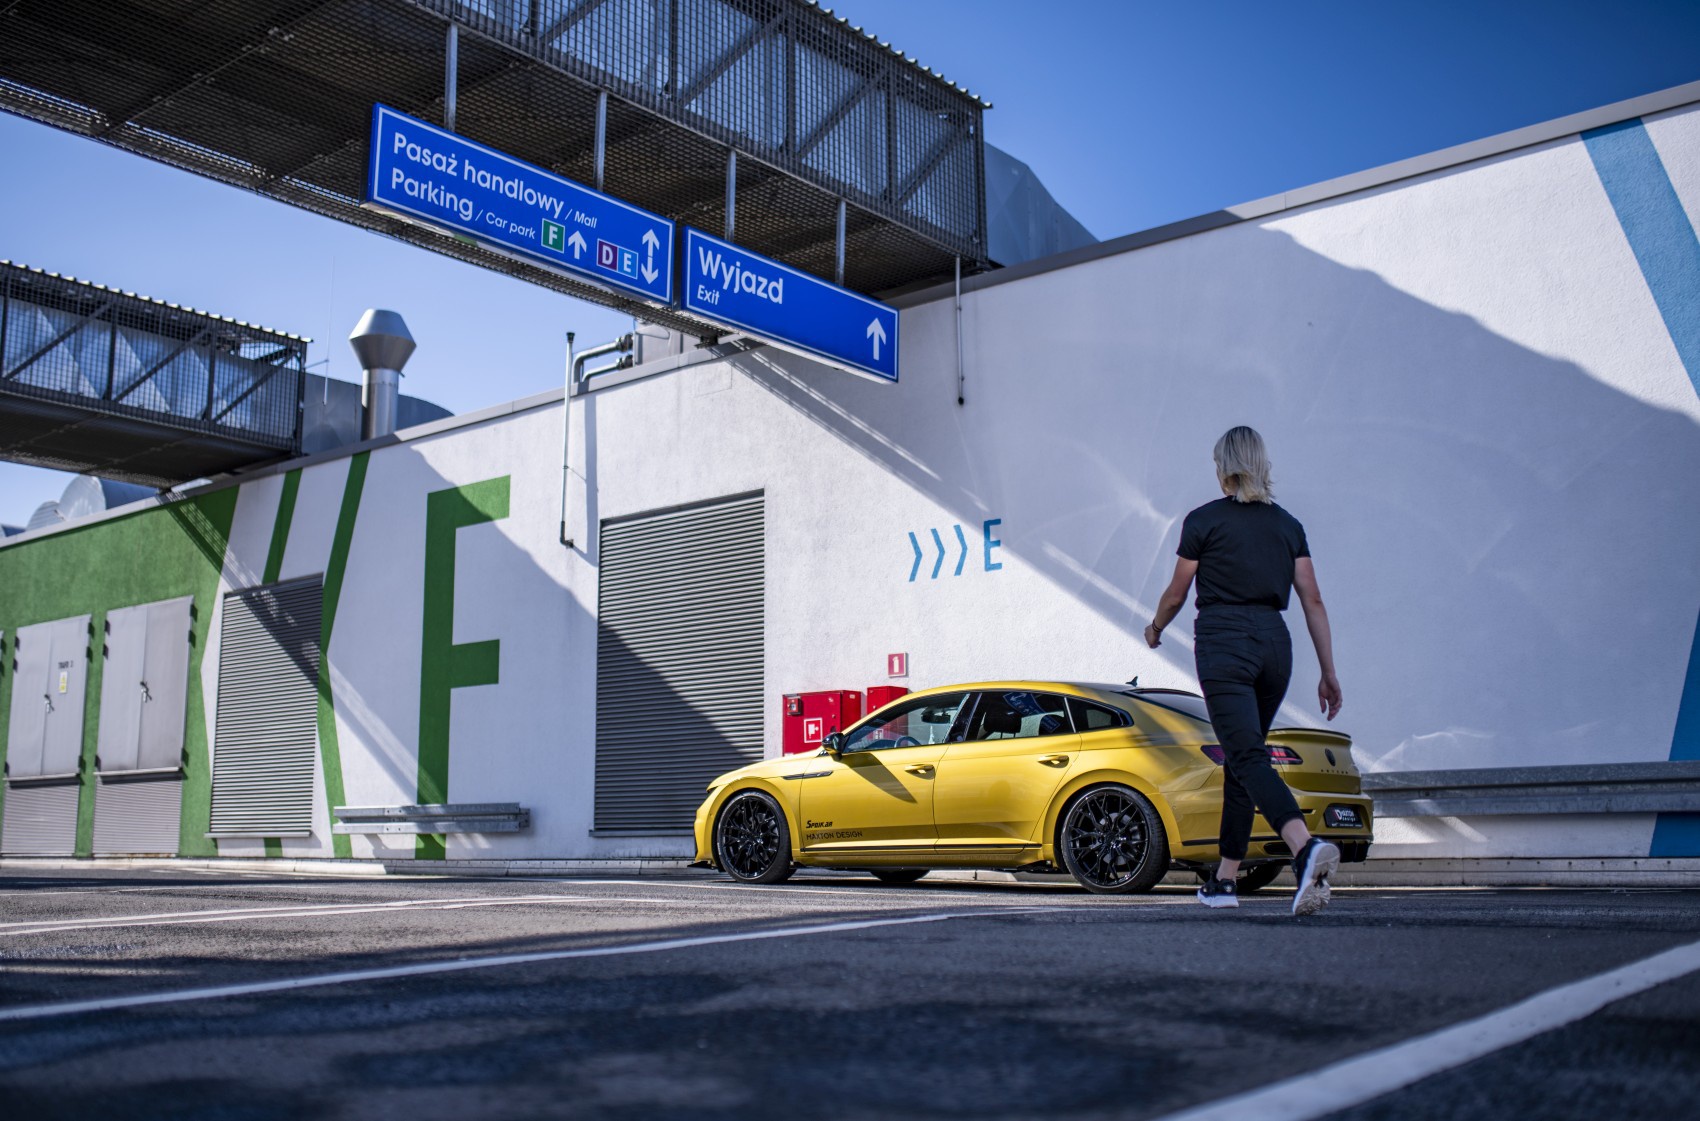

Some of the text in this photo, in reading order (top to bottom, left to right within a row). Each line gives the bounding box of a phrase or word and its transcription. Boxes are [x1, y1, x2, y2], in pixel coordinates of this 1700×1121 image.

[394, 132, 457, 177] Pasaż
[464, 159, 564, 219] handlowy
[574, 211, 598, 229] Mall
[392, 167, 474, 222] Parking
[486, 212, 508, 230] Car
[509, 222, 536, 240] park
[548, 226, 558, 246] F
[602, 245, 614, 266] D
[623, 252, 632, 273] E
[697, 284, 720, 306] Exit
[698, 246, 784, 305] Wyjazd
[983, 518, 1002, 572] E
[415, 474, 511, 861] F
[836, 831, 863, 839] DESIGN
